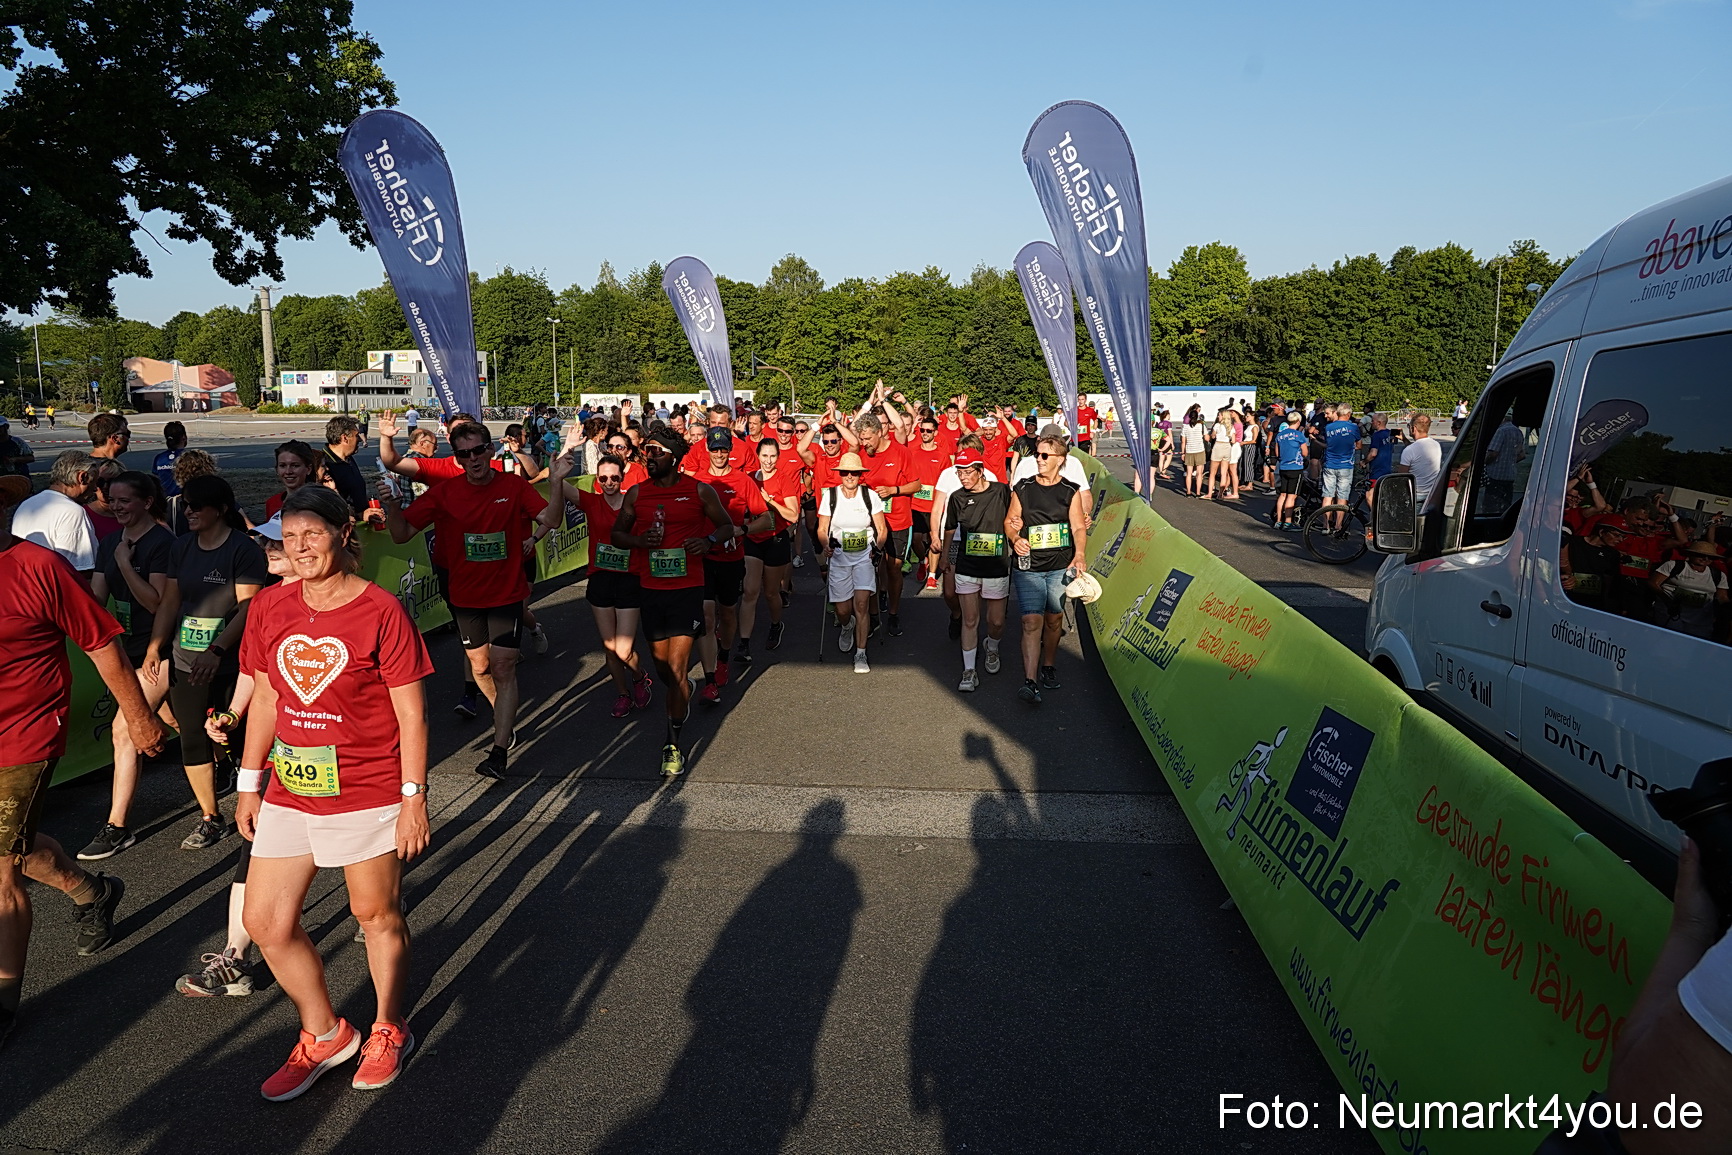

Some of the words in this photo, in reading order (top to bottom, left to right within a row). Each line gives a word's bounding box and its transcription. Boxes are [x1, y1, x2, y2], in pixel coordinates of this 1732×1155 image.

[1630, 280, 1677, 304] ...timing
[1587, 411, 1631, 441] Fischer
[472, 542, 500, 553] 1673
[847, 537, 865, 546] 1739
[973, 541, 989, 550] 272
[601, 552, 625, 563] 1704
[655, 558, 680, 568] 1676
[189, 628, 211, 640] 751
[1125, 615, 1187, 671] firmenlauf
[1551, 619, 1587, 649] official
[1588, 632, 1627, 671] timing
[292, 657, 326, 670] Sandra
[303, 721, 327, 730] Herz
[1544, 705, 1571, 728] powered
[1572, 717, 1581, 735] by
[284, 761, 317, 781] 249
[1313, 741, 1353, 778] Fischer
[326, 766, 335, 789] 2022
[1312, 763, 1344, 789] AUTOMOBILE
[1238, 834, 1288, 890] neumarkt
[1250, 780, 1401, 934] firmenlauf
[1416, 785, 1512, 886] Gesunde
[1521, 854, 1634, 986] Firmen
[1434, 873, 1525, 981] laufen
